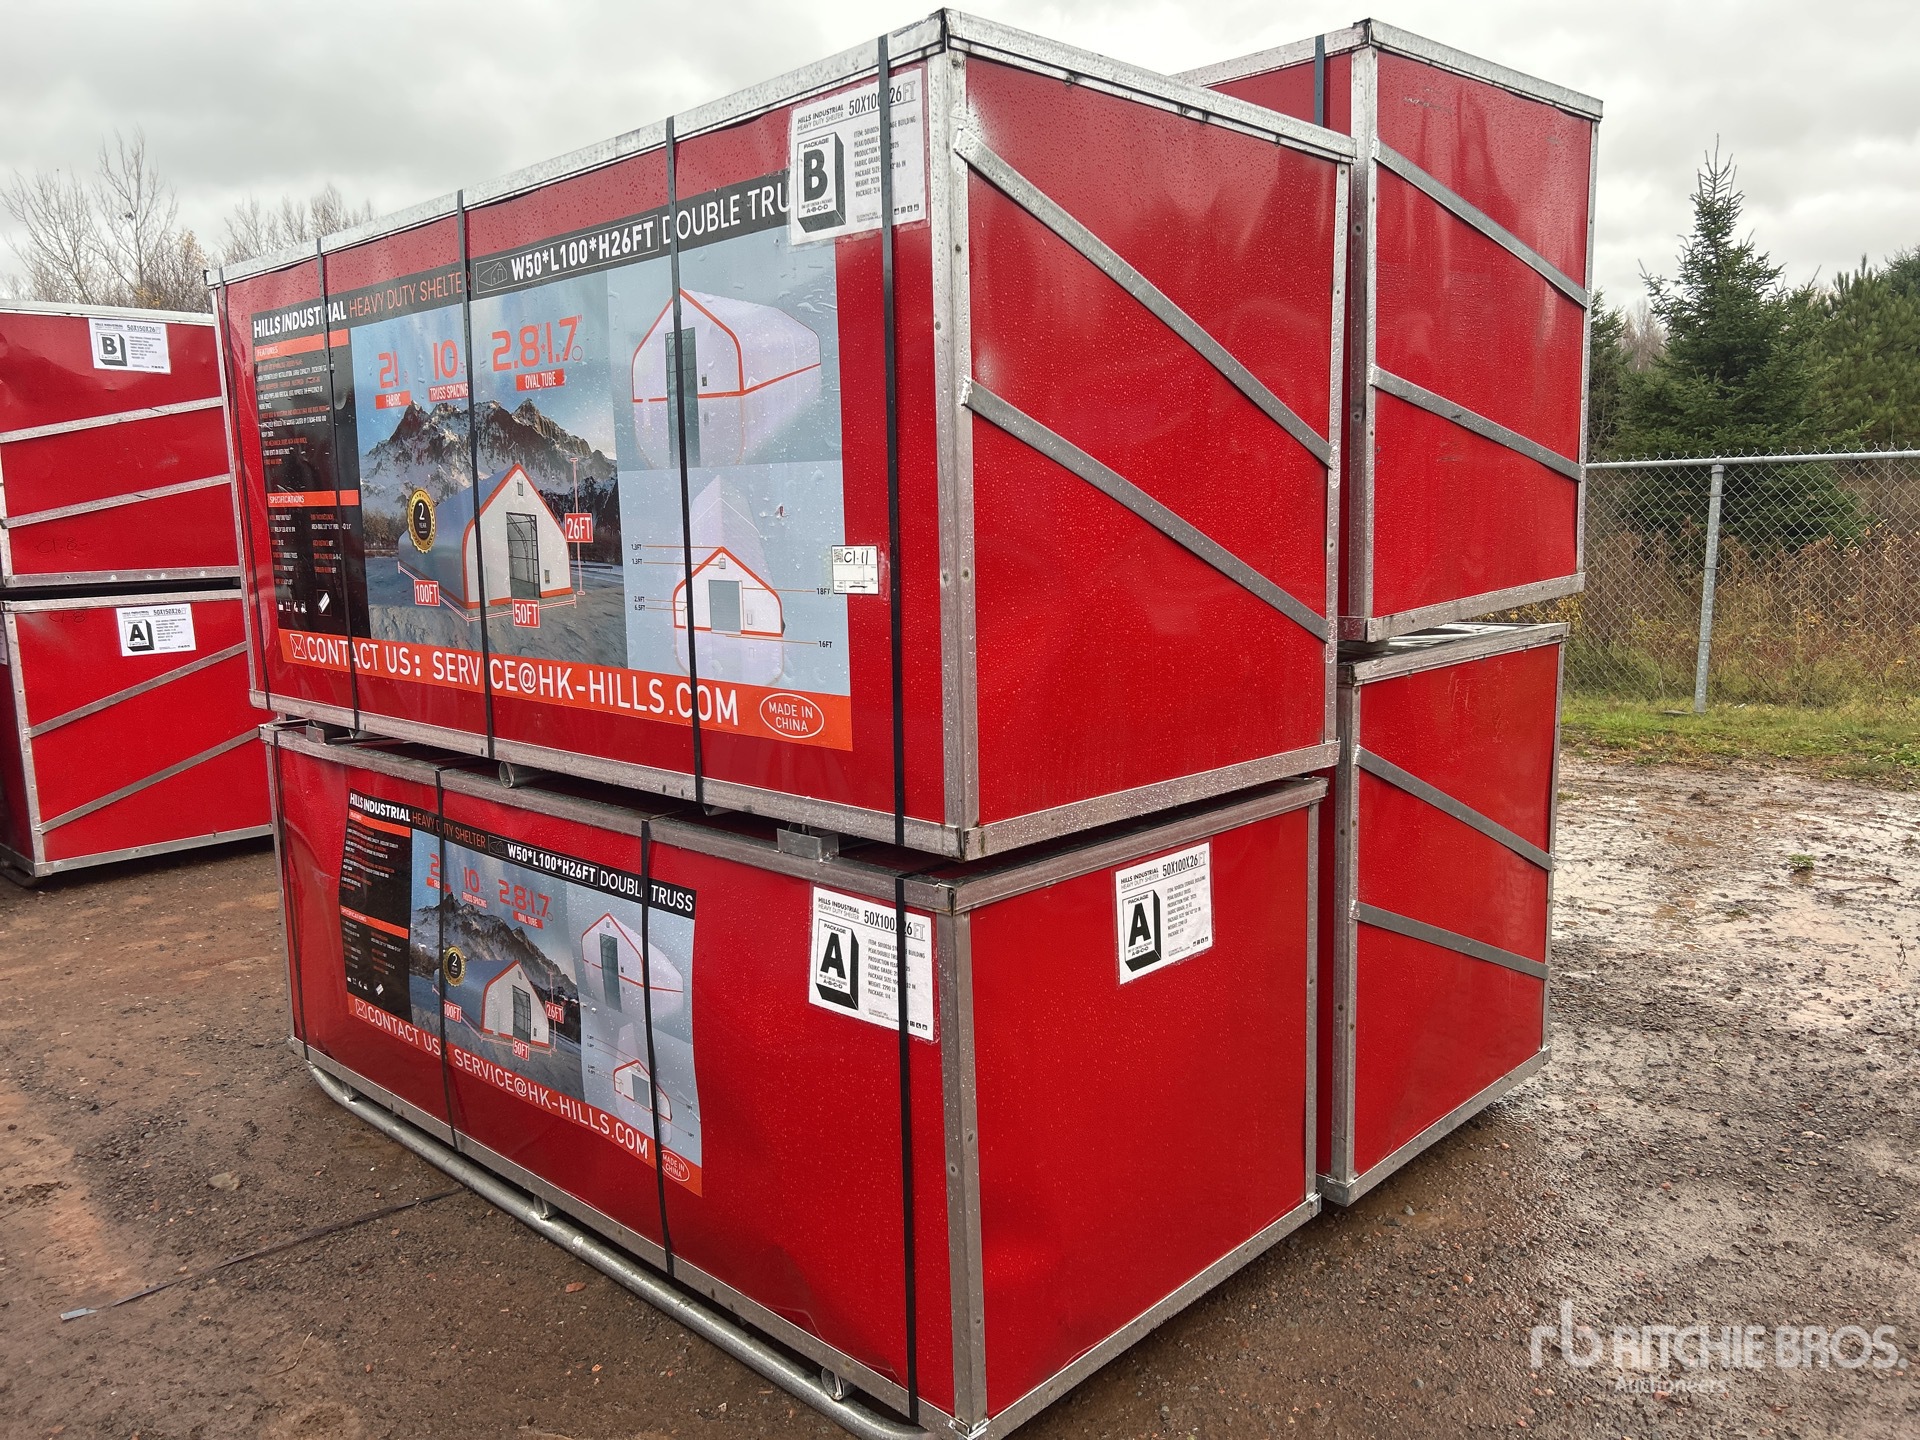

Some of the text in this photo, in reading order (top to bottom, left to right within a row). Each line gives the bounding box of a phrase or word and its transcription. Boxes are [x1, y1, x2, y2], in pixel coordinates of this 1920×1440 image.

[804, 138, 829, 149] PACKAGE
[804, 148, 828, 202] B
[254, 316, 281, 339] HILLS
[350, 293, 386, 318] HEAVY
[388, 285, 416, 310] DUTY
[748, 182, 792, 220] TRU
[102, 336, 118, 354] B
[433, 339, 458, 380] 10
[378, 350, 399, 389] 21
[525, 372, 556, 389] OVAL TUBE
[430, 384, 468, 401] TRUSS SPACING
[270, 495, 304, 504] SPECIFICATIONS
[418, 502, 425, 520] 2
[567, 516, 591, 540] 26FT
[416, 584, 439, 604] 100FT
[515, 602, 539, 625] 50FT
[130, 624, 146, 642] A
[307, 636, 738, 726] CONTACT US: SERVCE@HK-HILLS.COM
[768, 701, 814, 719] MADE IN
[776, 717, 808, 732] CHINA
[350, 792, 363, 808] HILLS
[364, 798, 410, 822] INDUSTRIAL
[412, 811, 434, 830] HEAVY
[436, 820, 454, 837] DTY
[455, 827, 486, 848] SHELTER
[600, 870, 643, 898] DOUBL
[651, 884, 694, 912] TRUSS
[464, 866, 480, 893] 10
[832, 900, 860, 914] INDUSTRIAL
[1128, 894, 1149, 904] PACKAGE
[824, 924, 846, 934] PACKAGE
[1128, 902, 1152, 948] A
[820, 932, 846, 980] A
[444, 1002, 460, 1020] 100FT
[546, 1004, 562, 1022] 26FT
[514, 1041, 529, 1058] 50FT
[367, 1006, 648, 1160] CONTACT US SERVICE@HK-HILLS.COM
[662, 1153, 685, 1172] MADE IN
[666, 1163, 683, 1178] CHINA
